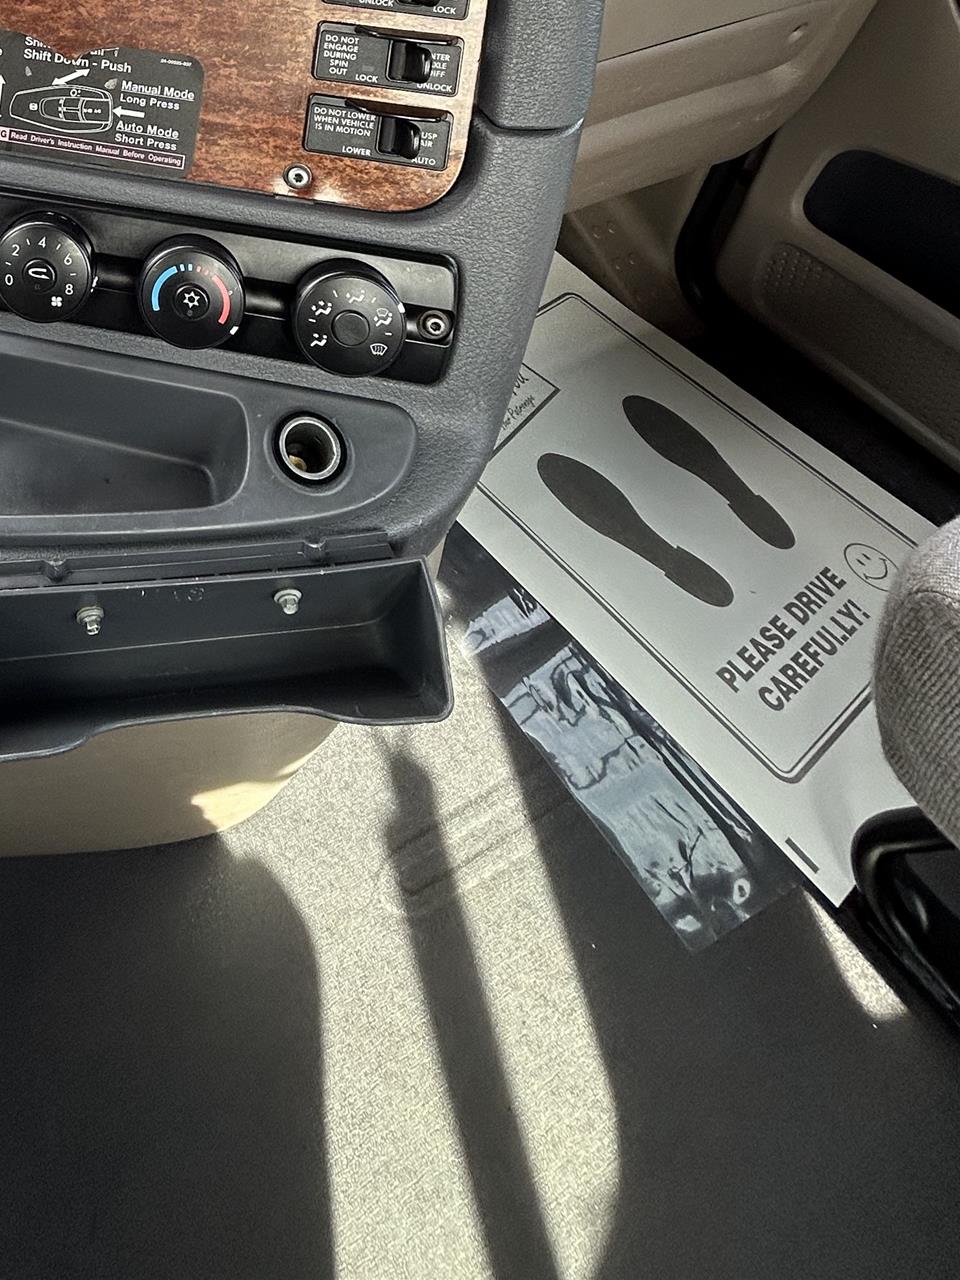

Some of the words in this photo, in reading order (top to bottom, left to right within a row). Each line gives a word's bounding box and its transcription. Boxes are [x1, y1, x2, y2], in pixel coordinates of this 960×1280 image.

[432, 6, 456, 15] LOCK
[325, 34, 339, 43] DO
[340, 36, 360, 45] NOT
[323, 42, 359, 53] ENGAGE
[23, 48, 53, 62] Shift
[100, 59, 132, 73] Push
[323, 50, 357, 61] DURING
[431, 53, 450, 62] NTER
[329, 59, 349, 68] SPIN
[431, 61, 448, 70] XLE
[328, 66, 348, 76] OUT
[355, 74, 379, 83] LOCK
[121, 80, 162, 94] Manual
[163, 86, 195, 100] Mode
[416, 82, 453, 93] UNLOCK
[120, 93, 147, 107] Long
[149, 97, 180, 110] Press
[314, 106, 328, 115] DO
[328, 108, 347, 117] NOT
[347, 111, 377, 122] LOWER
[313, 114, 340, 124] WHEN
[340, 118, 375, 130] VEHICLE
[116, 120, 143, 133] Auto
[147, 124, 179, 138] Mode
[315, 122, 323, 130] IS
[324, 124, 334, 132] IN
[335, 126, 371, 137] MOTION
[421, 131, 438, 140] USP
[115, 133, 144, 146] Short
[146, 137, 177, 151] Press
[10, 131, 28, 141] Read
[30, 135, 55, 145] Driver's
[57, 139, 93, 151] Instruction
[96, 144, 120, 156] Manual
[123, 150, 145, 160] Before
[148, 153, 181, 167] Operating
[341, 145, 371, 156] LOWER
[411, 157, 436, 166] AUTO
[38, 236, 47, 248] 4
[11, 244, 20, 257] 2
[64, 253, 73, 266] 6
[5, 274, 14, 286] 0
[65, 283, 74, 295] 8
[715, 614, 797, 694] PLEASE
[783, 566, 847, 626] DRIVE
[758, 599, 871, 711] CAREFULLY!
